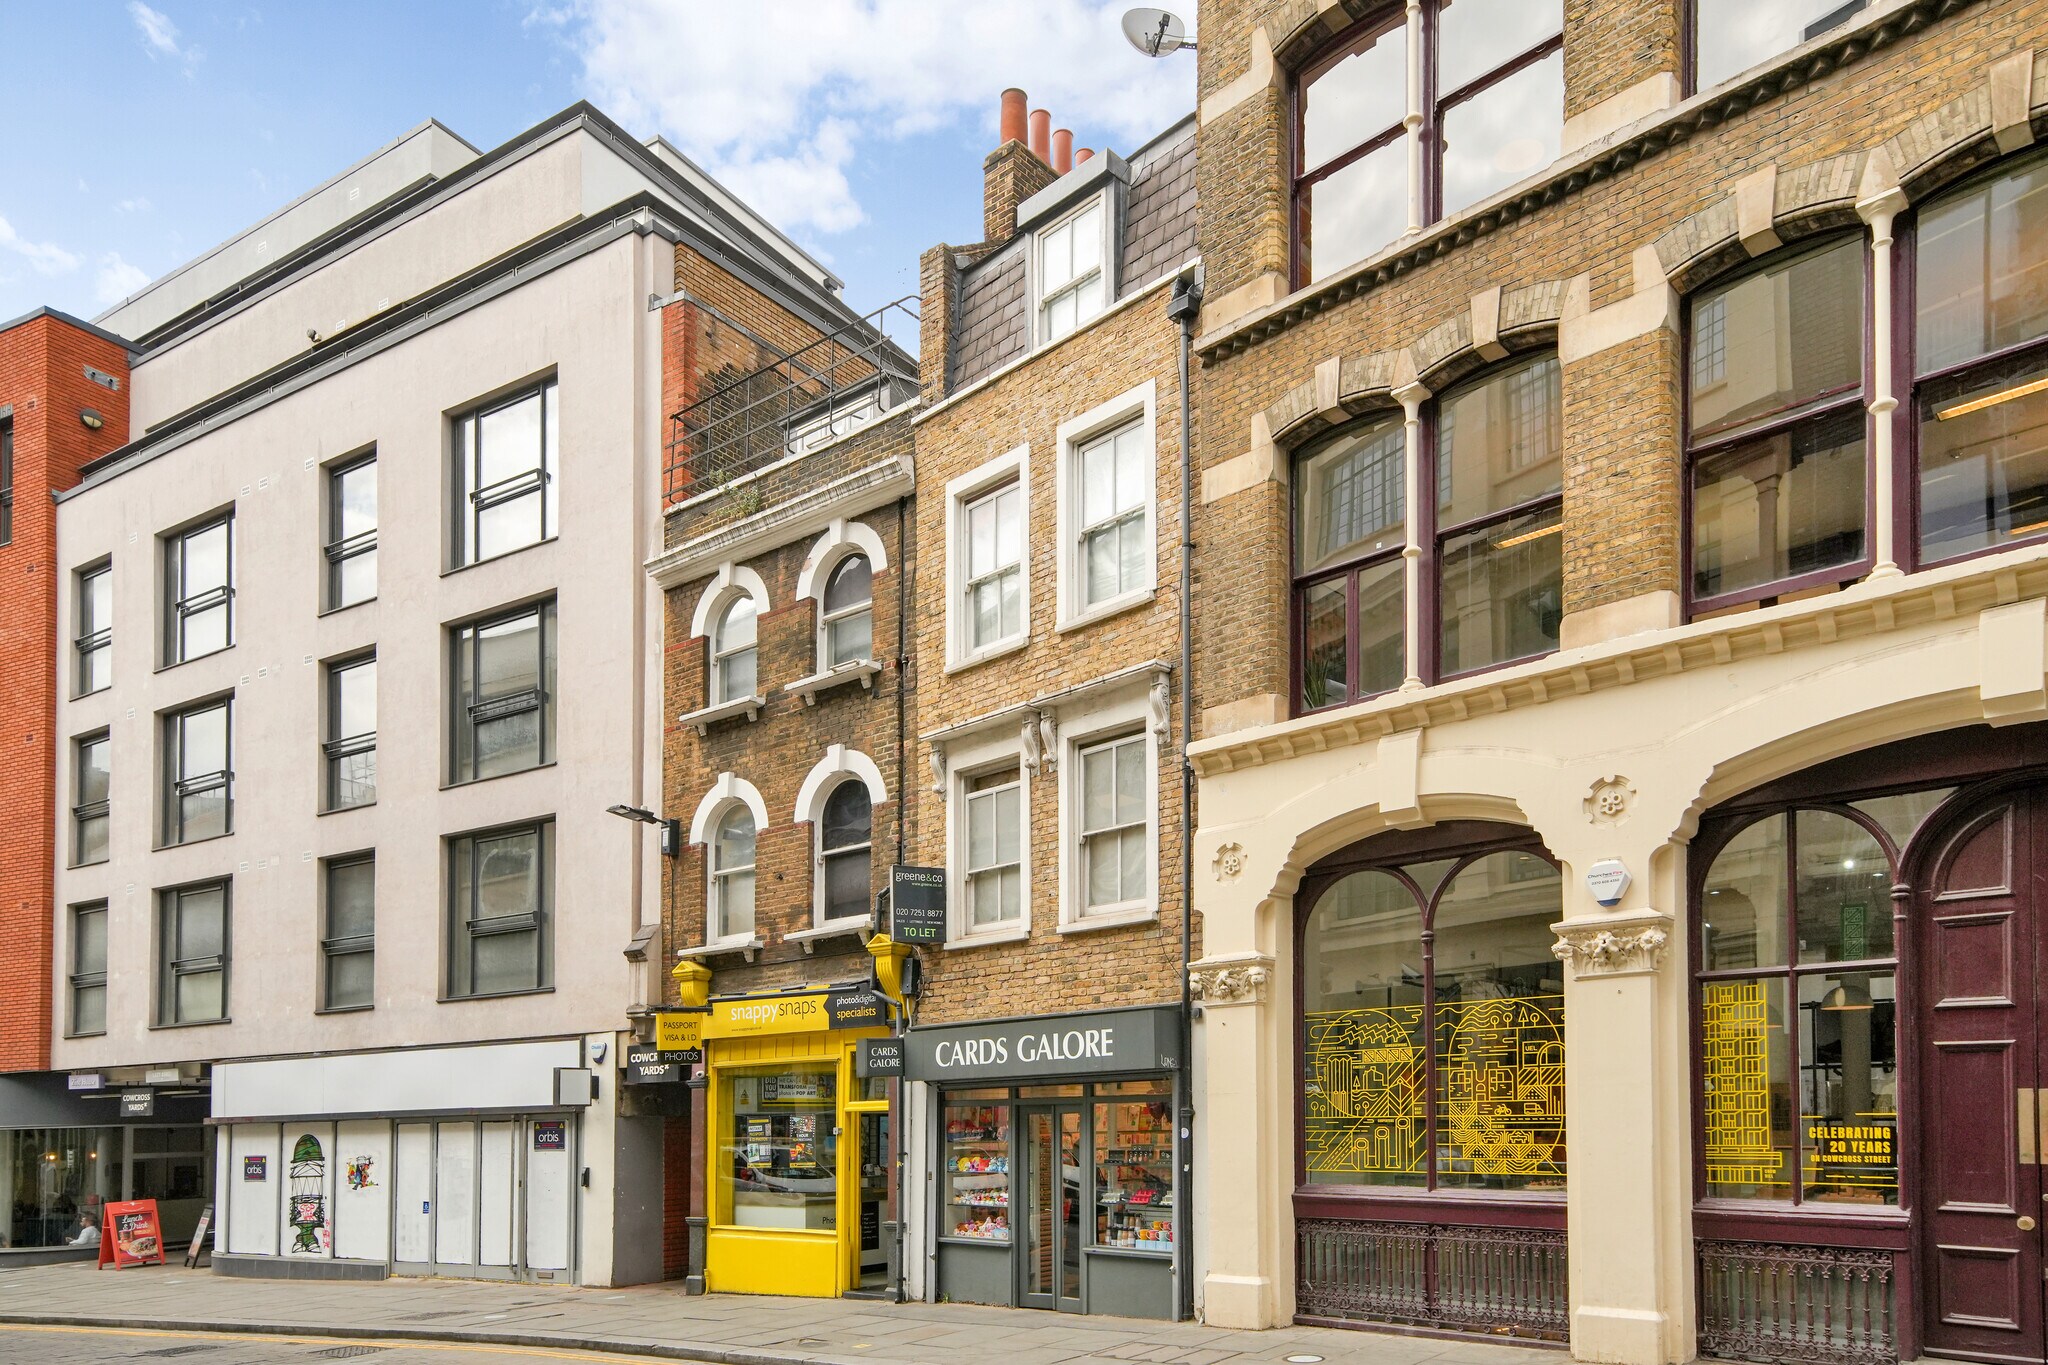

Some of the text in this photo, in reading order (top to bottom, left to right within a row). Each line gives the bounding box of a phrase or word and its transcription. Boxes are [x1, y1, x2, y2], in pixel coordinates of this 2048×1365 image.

[895, 872, 943, 882] greene&co
[896, 908, 944, 918] 020 7251 8877
[904, 927, 936, 938] TO LET
[836, 994, 877, 1007] photo&digital
[731, 1000, 816, 1025] snappysnaps
[836, 1006, 877, 1021] specialists
[871, 1046, 898, 1057] CARDS
[934, 1028, 1114, 1067] CARDS GALORE
[664, 1052, 698, 1060] PHOTOS
[870, 1058, 900, 1068] GALORE
[122, 1094, 150, 1102] COWCROSS
[538, 1131, 559, 1142] orbis
[1808, 1127, 1891, 1139] CELEBRATING
[1830, 1141, 1891, 1154] 20 YEARS
[247, 1164, 262, 1174] orbis
